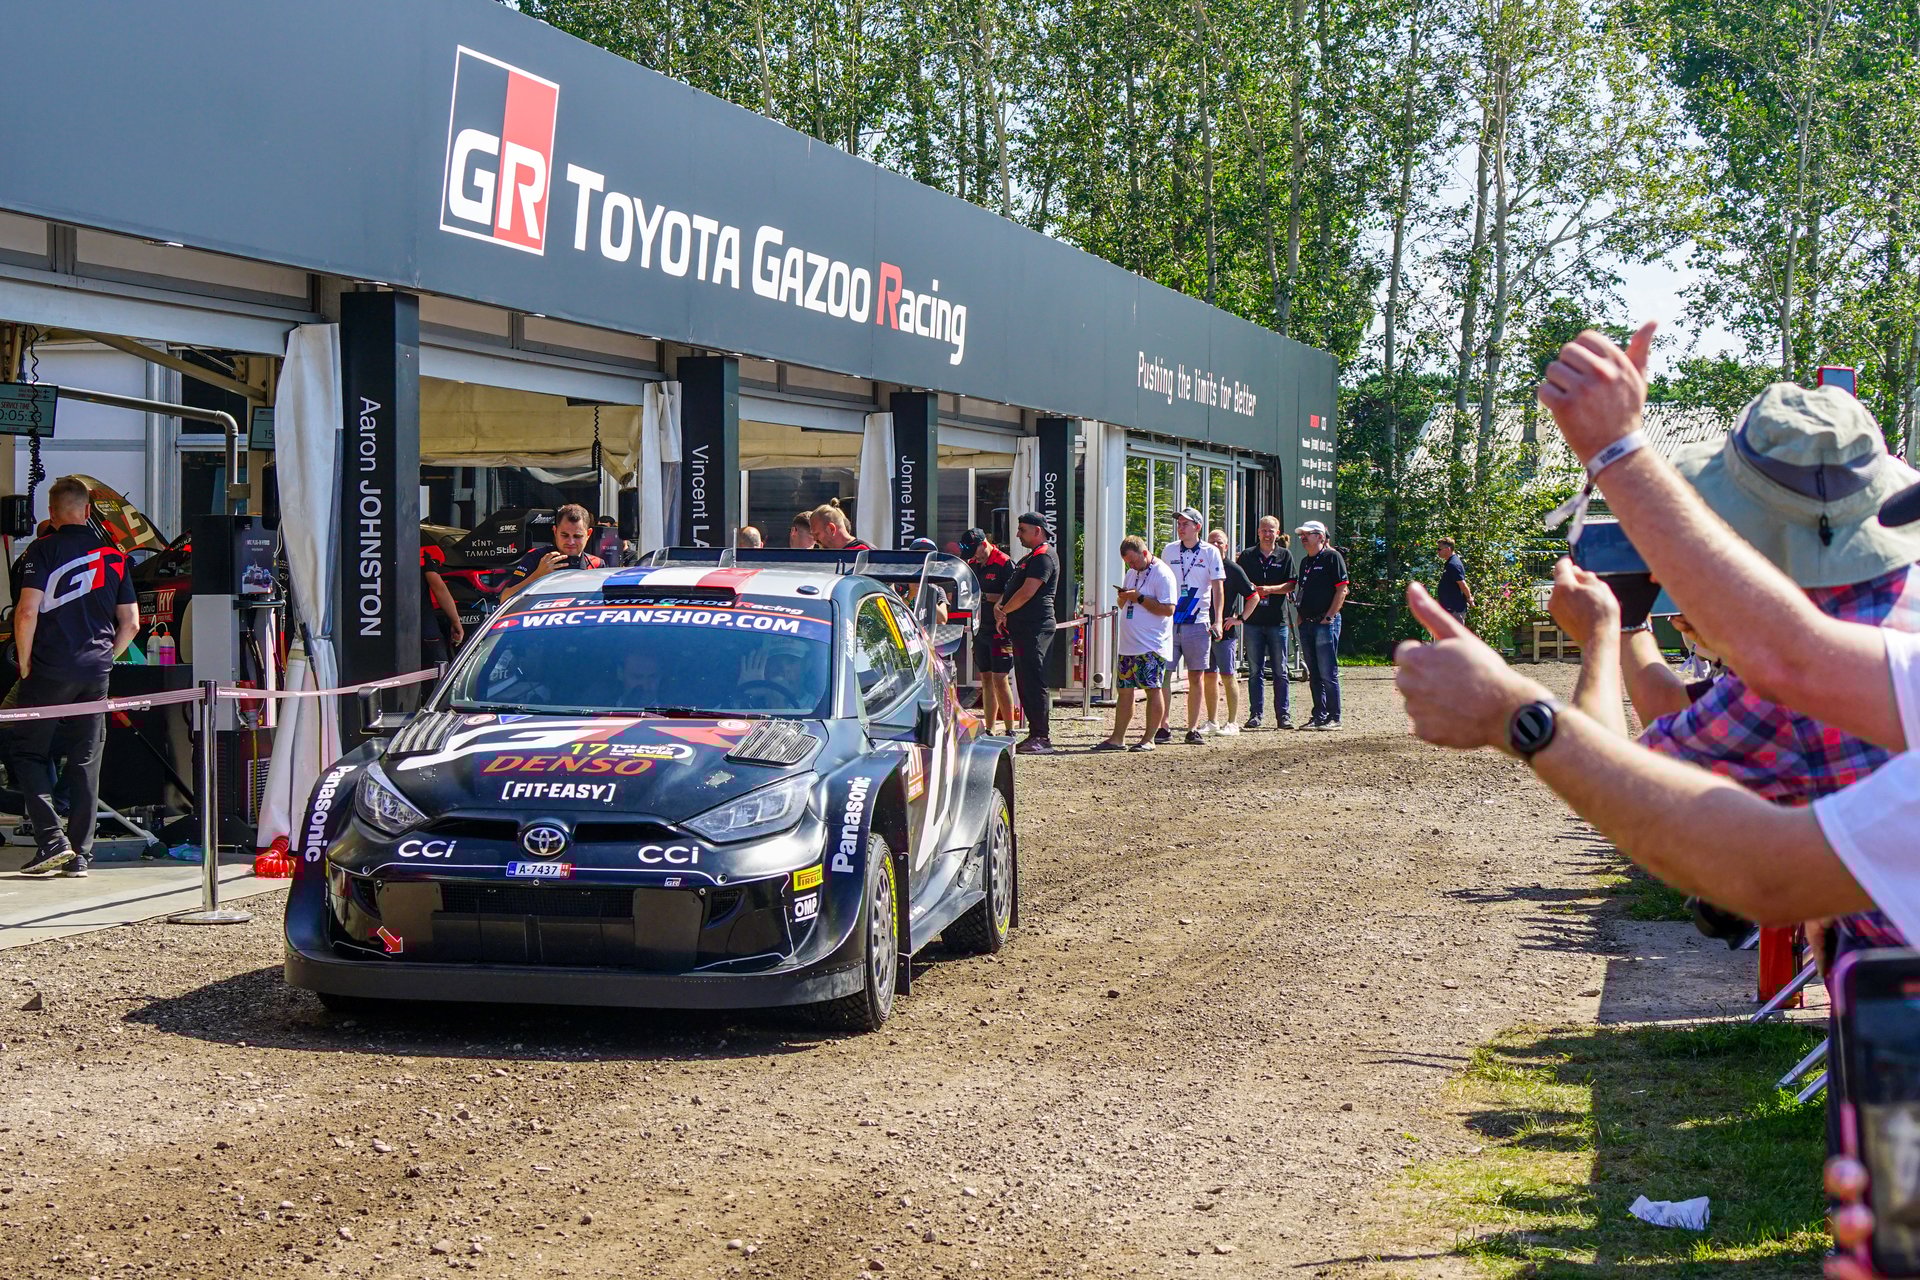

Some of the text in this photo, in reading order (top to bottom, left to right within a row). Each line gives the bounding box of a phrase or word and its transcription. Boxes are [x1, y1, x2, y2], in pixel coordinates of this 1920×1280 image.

[448, 128, 547, 240] GR
[566, 162, 968, 365] TOYOTA GAZOO Racing
[1137, 350, 1257, 417] Pushing the limits for Better
[691, 444, 710, 548] Vincent LA
[1044, 472, 1058, 506] Scott
[901, 455, 916, 550] Jonne HAL
[359, 396, 382, 636] Aaron JOHNSTON
[496, 544, 518, 554] Stilo
[158, 592, 175, 612] HY
[577, 598, 654, 607] TOYOTA
[659, 598, 733, 607] GAZOO
[736, 601, 804, 615] Racing
[521, 609, 801, 634] WRC-FANSHOP.COM
[569, 743, 610, 756] 17
[484, 755, 654, 775] DENSO
[501, 780, 617, 802] [FIT-EASY]
[304, 764, 358, 862] Panasonic
[831, 776, 872, 873] Panasonic
[518, 864, 558, 875] A-7437
[797, 868, 823, 887] PIRELLI
[794, 897, 818, 918] OMP
